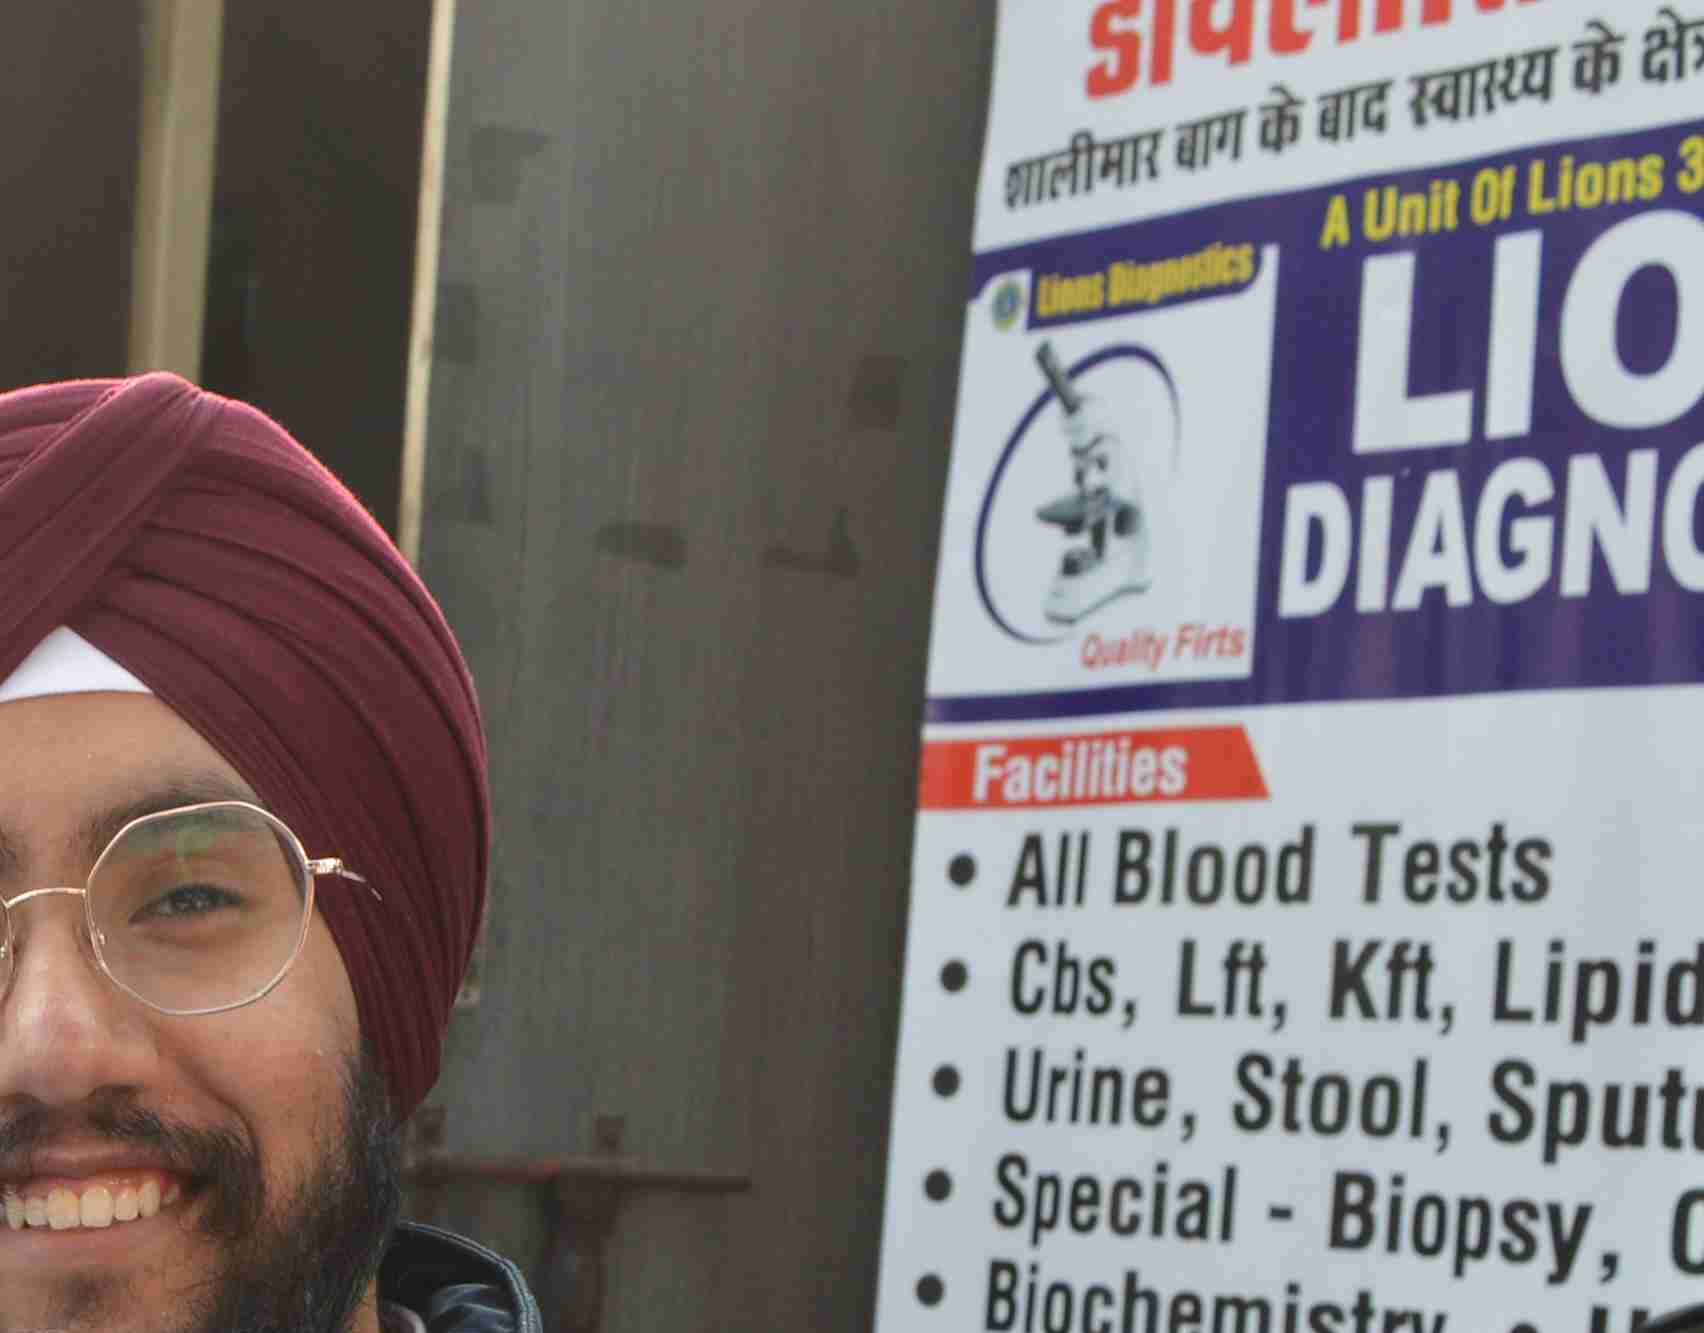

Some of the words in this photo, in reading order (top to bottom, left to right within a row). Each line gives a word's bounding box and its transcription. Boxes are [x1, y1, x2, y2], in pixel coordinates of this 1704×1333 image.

[1005, 128, 1164, 212] शालीमार
[1175, 107, 1247, 170] बाग
[1259, 83, 1305, 154] के
[1317, 80, 1393, 145] बाद
[1409, 46, 1559, 128] स्वास्थ्य
[1572, 20, 1626, 94] के
[1319, 195, 1351, 250] A
[1362, 178, 1460, 242] Unit
[1471, 165, 1516, 225] Of
[1528, 152, 1664, 214] Lions
[1037, 272, 1105, 318] Lions
[1108, 241, 1255, 307] Diagnostics
[1081, 628, 1165, 672] Quality
[972, 742, 1189, 801] Facilities
[1007, 829, 1089, 908] All
[1113, 822, 1316, 907] Blood
[1352, 822, 1554, 906] Tests
[1010, 940, 1139, 1031] Cbs,
[1176, 938, 1288, 1032] Lft,
[1330, 938, 1455, 1035] Kft,
[1002, 1046, 1197, 1144] Urine,
[1234, 1051, 1450, 1153] Stool,
[1487, 1058, 1704, 1167] Sput
[993, 1153, 1237, 1248] Special
[1328, 1169, 1620, 1286] Biopsy,
